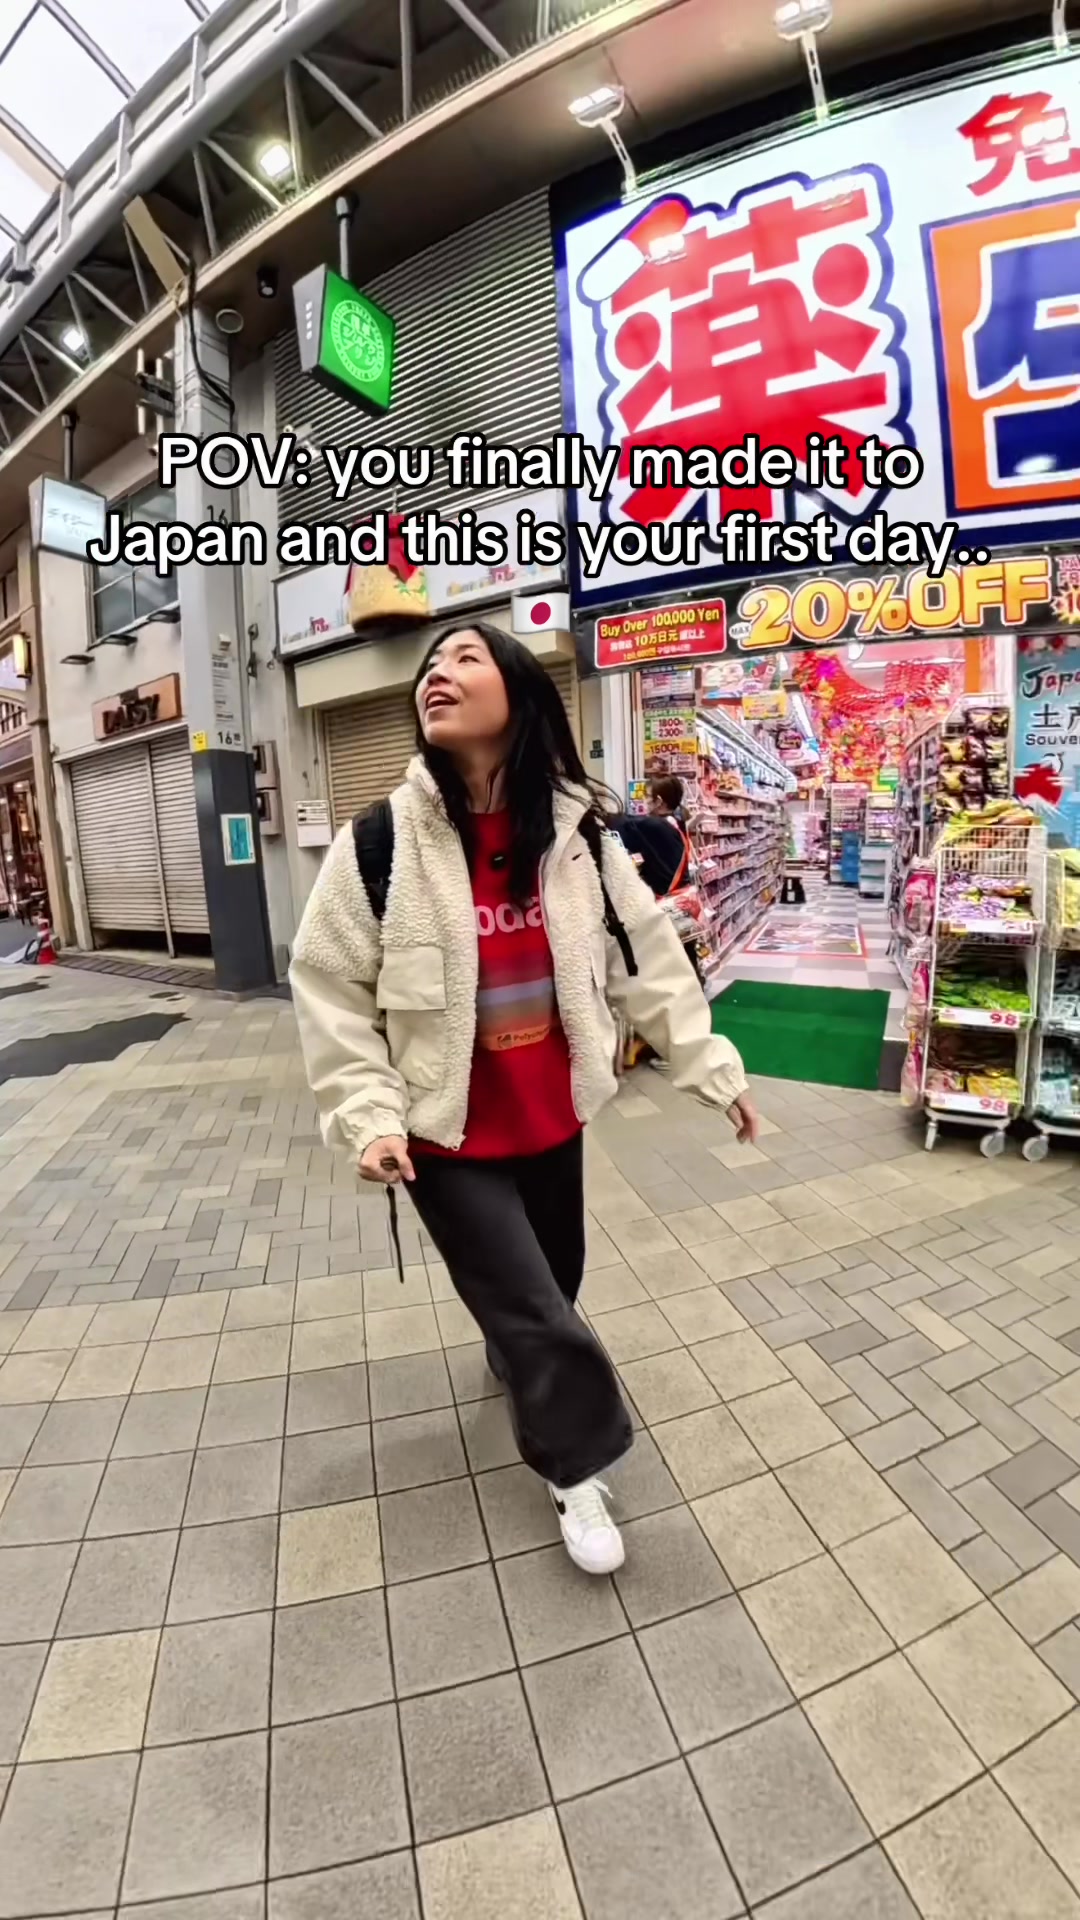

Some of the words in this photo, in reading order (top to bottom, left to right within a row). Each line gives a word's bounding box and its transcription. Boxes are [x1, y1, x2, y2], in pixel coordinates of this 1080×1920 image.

[610, 188, 890, 527] 薬
[738, 555, 1051, 650] 20%OFF
[600, 623, 621, 638] Buy
[623, 619, 649, 634] Over
[652, 609, 696, 626] 100,000
[697, 608, 720, 622] Yen
[1025, 733, 1080, 746] Souve
[989, 1011, 1018, 1027] 98
